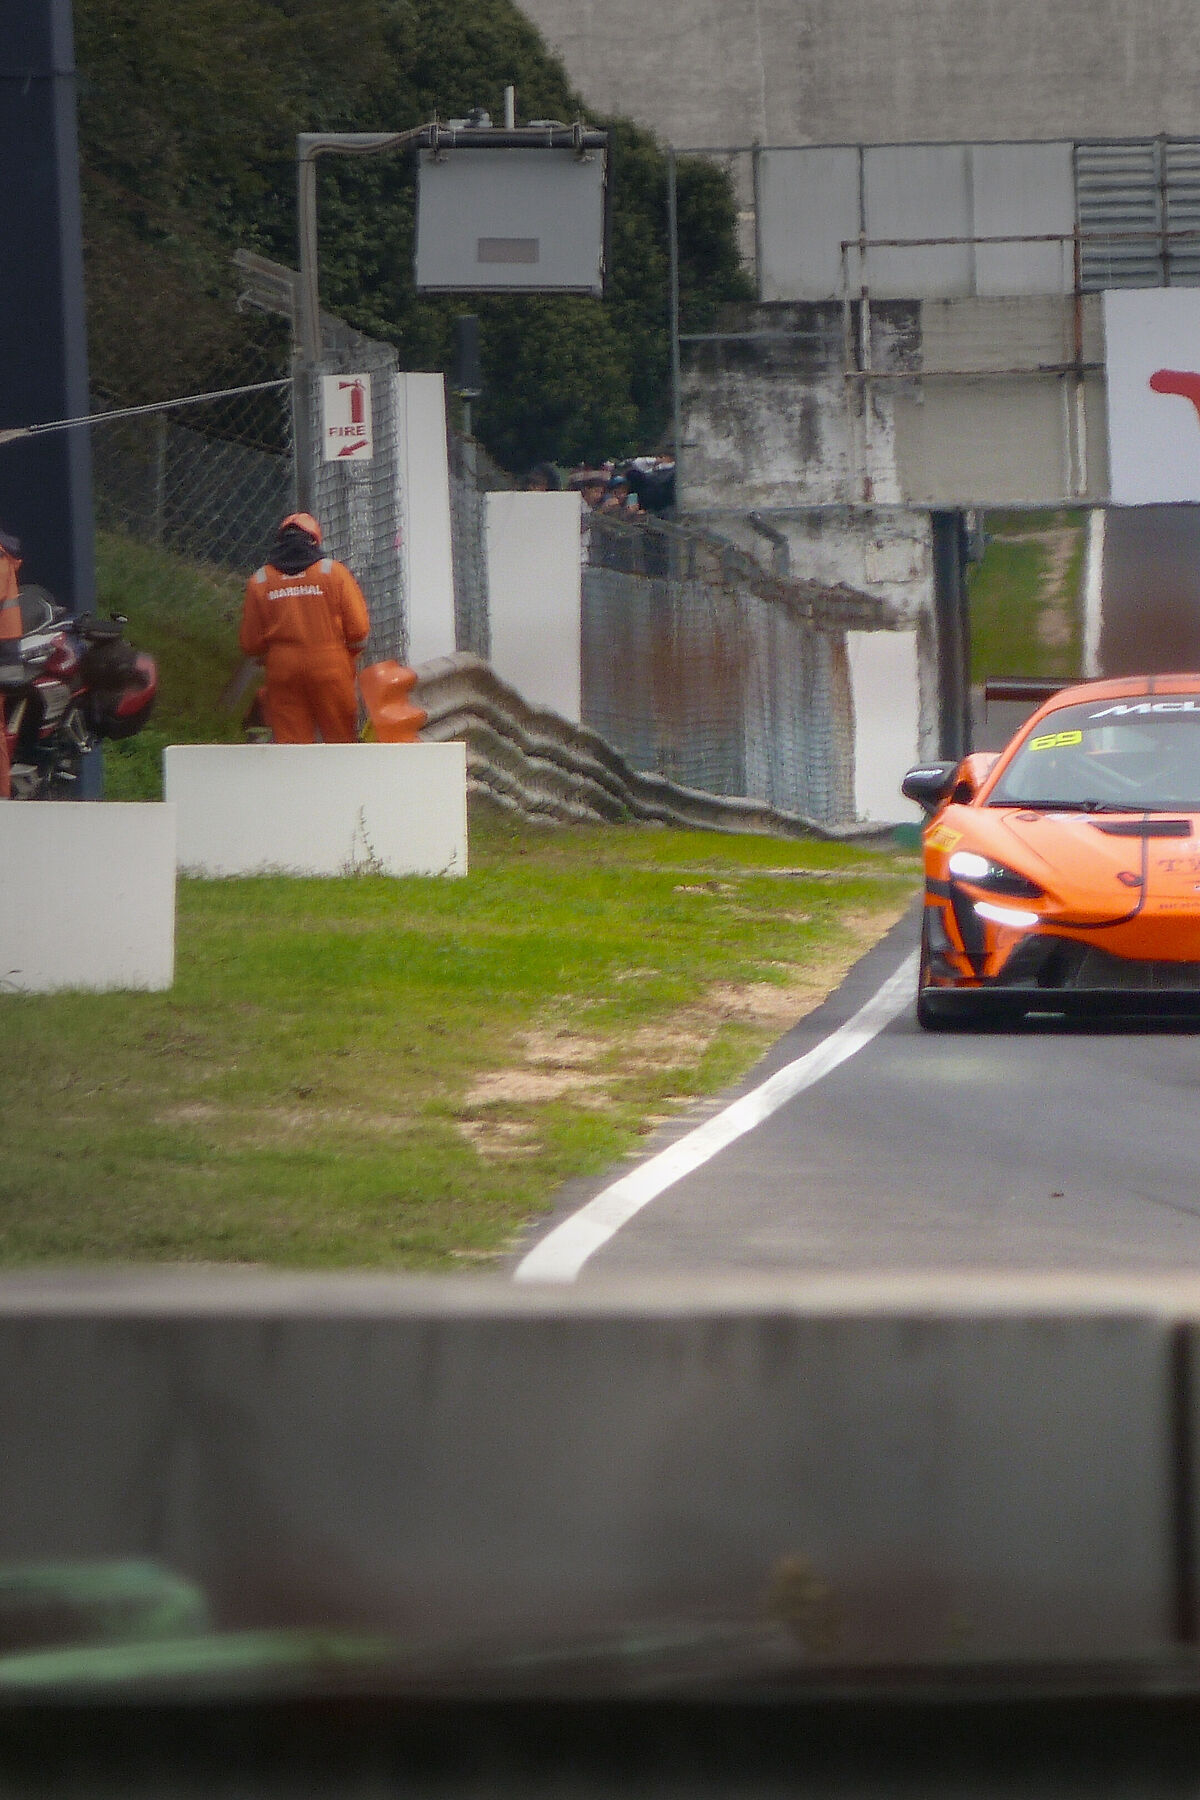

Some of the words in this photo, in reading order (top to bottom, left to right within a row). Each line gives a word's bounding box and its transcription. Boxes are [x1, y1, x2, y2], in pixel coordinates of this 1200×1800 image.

[329, 425, 366, 437] FIRE
[268, 585, 324, 600] MARSHAL
[1030, 730, 1082, 751] 69
